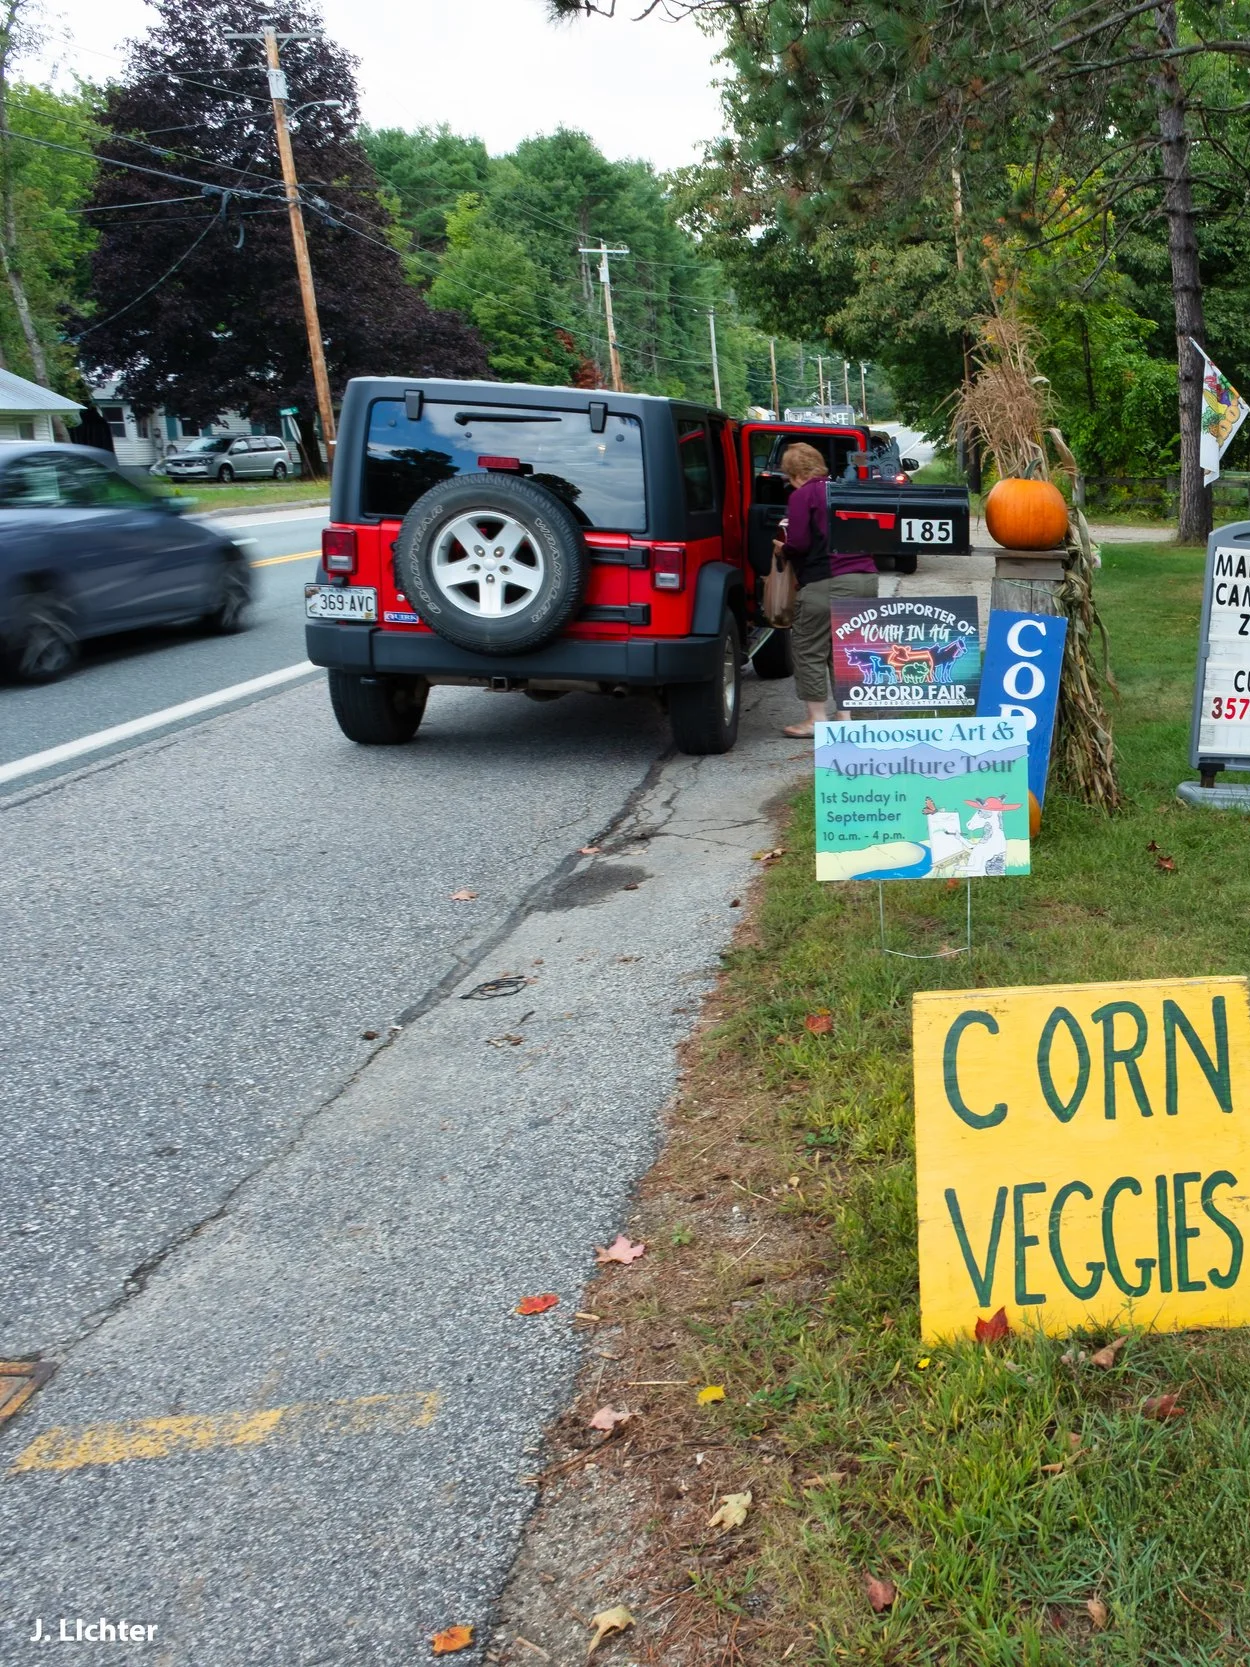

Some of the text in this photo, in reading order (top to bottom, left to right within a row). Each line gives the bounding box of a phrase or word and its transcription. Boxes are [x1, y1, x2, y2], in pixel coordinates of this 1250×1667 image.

[905, 520, 950, 542] 185
[835, 603, 977, 640] PROUD SUPPORTER OF
[860, 623, 951, 643] YOUTH IN AG
[850, 685, 967, 701] OXFORD FAIR
[826, 721, 1014, 744] Mahoosuc Art &
[826, 755, 1017, 781] Agriculture Tour
[821, 789, 906, 808] 1st Sunday in
[827, 809, 902, 826] September
[823, 831, 835, 841] 10
[838, 832, 861, 841] a.m.
[872, 831, 880, 840] 4
[882, 832, 906, 843] p.m.
[943, 996, 1233, 1130] CORN
[945, 1169, 1244, 1309] VEGGIES
